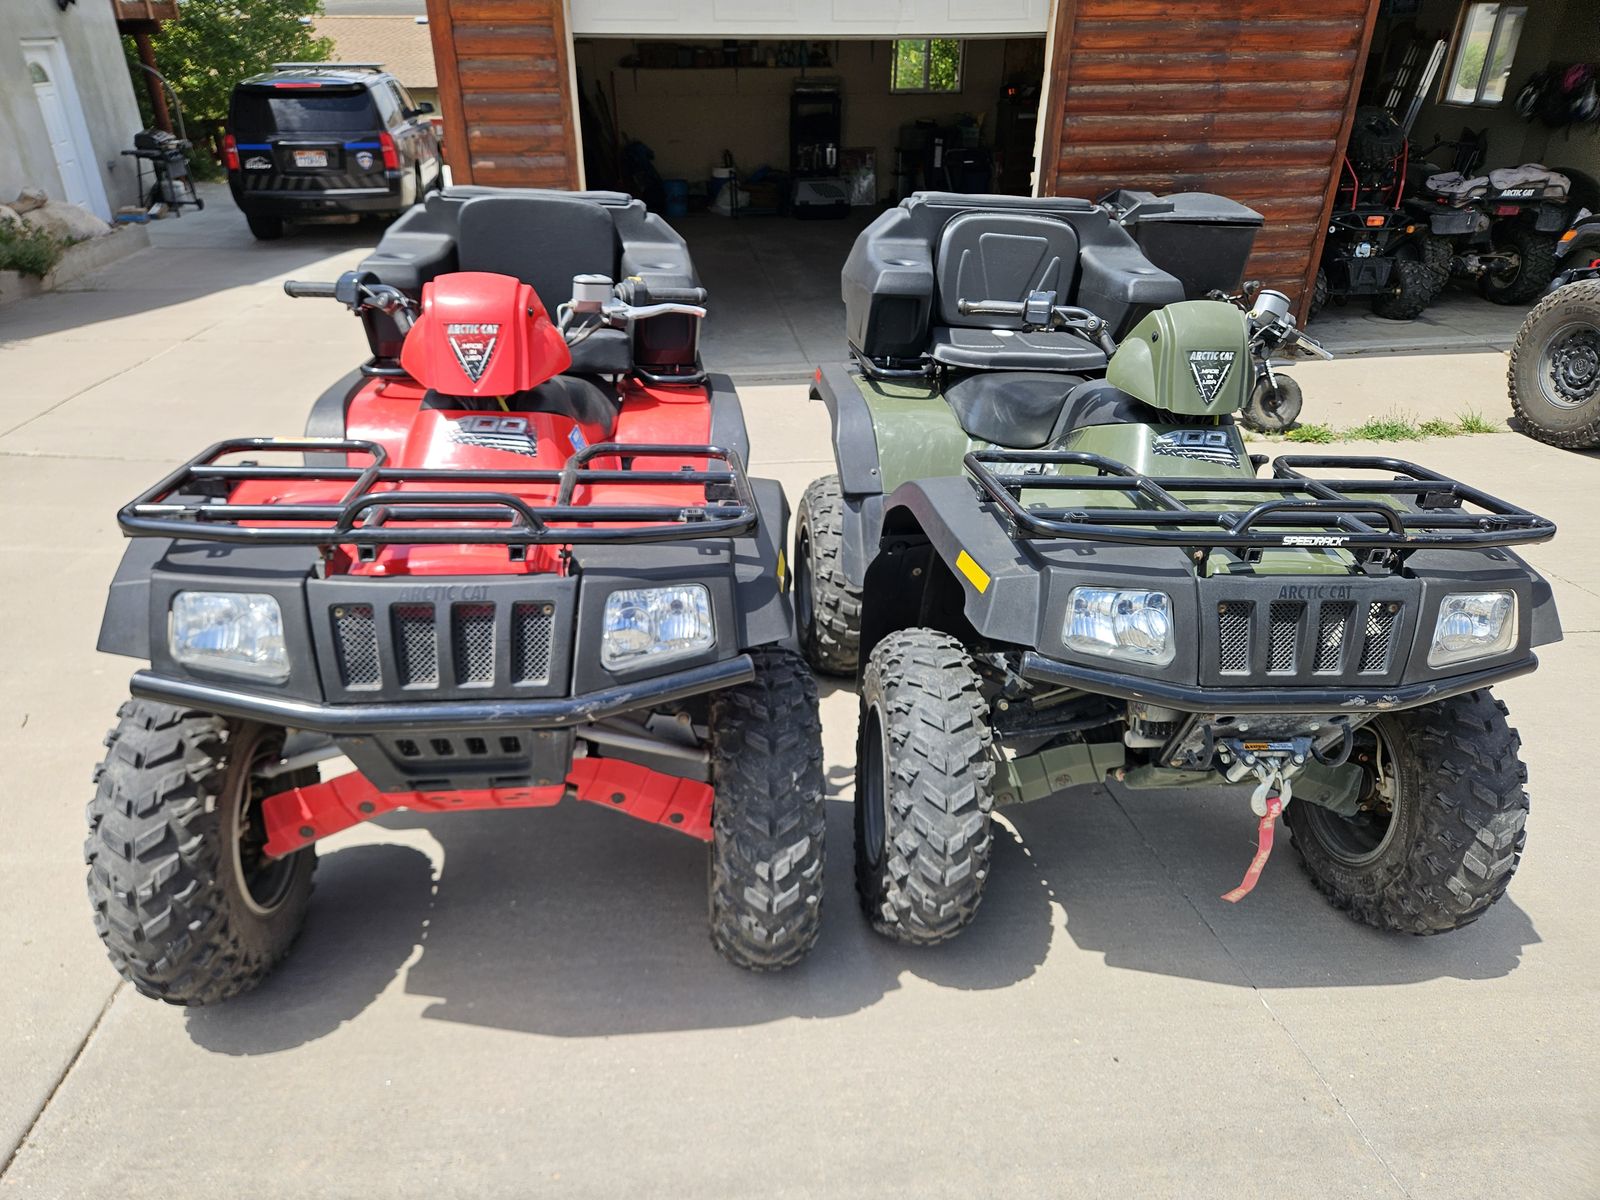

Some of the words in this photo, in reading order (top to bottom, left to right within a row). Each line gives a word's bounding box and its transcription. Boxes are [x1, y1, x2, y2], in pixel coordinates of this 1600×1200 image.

[448, 324, 479, 334] ARCTIC
[480, 324, 499, 334] CAT
[1190, 351, 1219, 360] ARCTIC
[1220, 351, 1234, 360] CAT
[1157, 429, 1227, 446] 400
[399, 585, 456, 600] ARCTIC
[461, 585, 490, 600] CAT
[1279, 585, 1324, 599] ARCTIC
[1330, 585, 1353, 599] CAT
